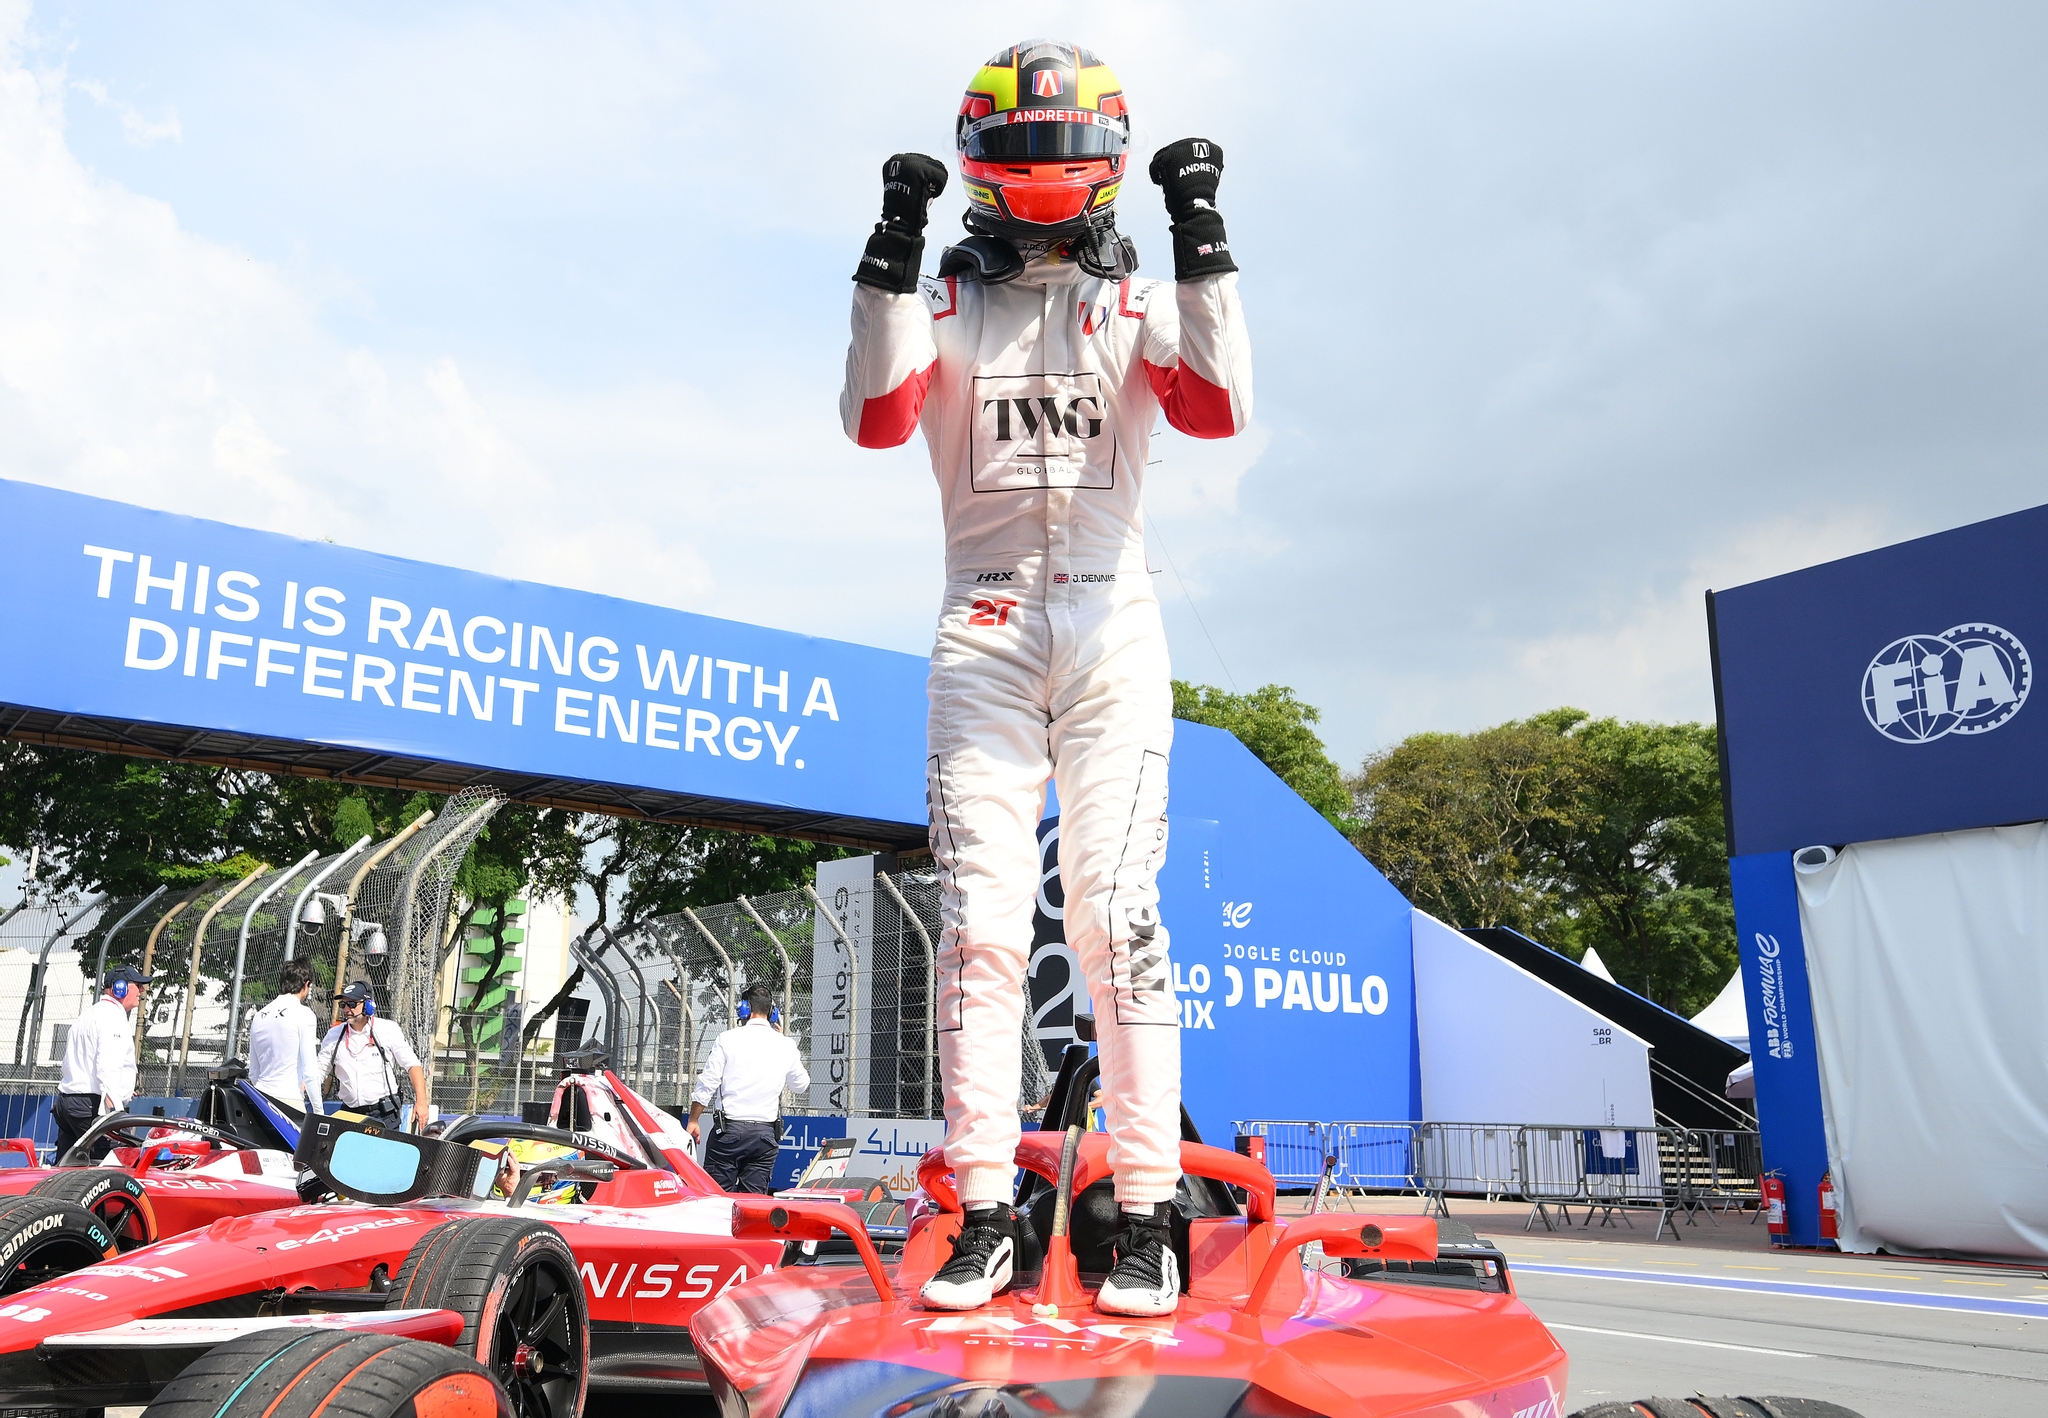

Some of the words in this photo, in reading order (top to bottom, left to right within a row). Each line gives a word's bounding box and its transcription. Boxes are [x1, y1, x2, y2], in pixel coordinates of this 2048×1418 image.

[1014, 110, 1088, 122] ANDRETTI
[883, 181, 910, 195] DRETTI
[983, 397, 1103, 441] TWG
[976, 571, 1015, 582] HRX
[968, 600, 1018, 626] 27
[83, 544, 260, 622] THIS
[282, 580, 346, 636] IS
[367, 595, 620, 683] RACING
[636, 643, 789, 713] WITH
[801, 676, 840, 722] A
[124, 616, 540, 726] DIFFERENT
[554, 686, 805, 770] ENERGY.
[853, 887, 861, 964] RAZIL
[1223, 944, 1281, 961] OOGLE
[1289, 949, 1347, 967] CLOUD
[1254, 967, 1389, 1016] PAULO
[1775, 959, 1786, 1012] CHAMPIONSHIP
[1592, 1028, 1612, 1036] SAO
[1781, 1014, 1789, 1040] WORLD
[1767, 1028, 1781, 1059] ABB
[828, 1033, 846, 1118] ACE
[572, 1132, 617, 1158] NISSAN
[581, 1262, 775, 1299] NISSA
[0, 1304, 52, 1322] BB
[964, 1339, 1094, 1352] GLOBAL
